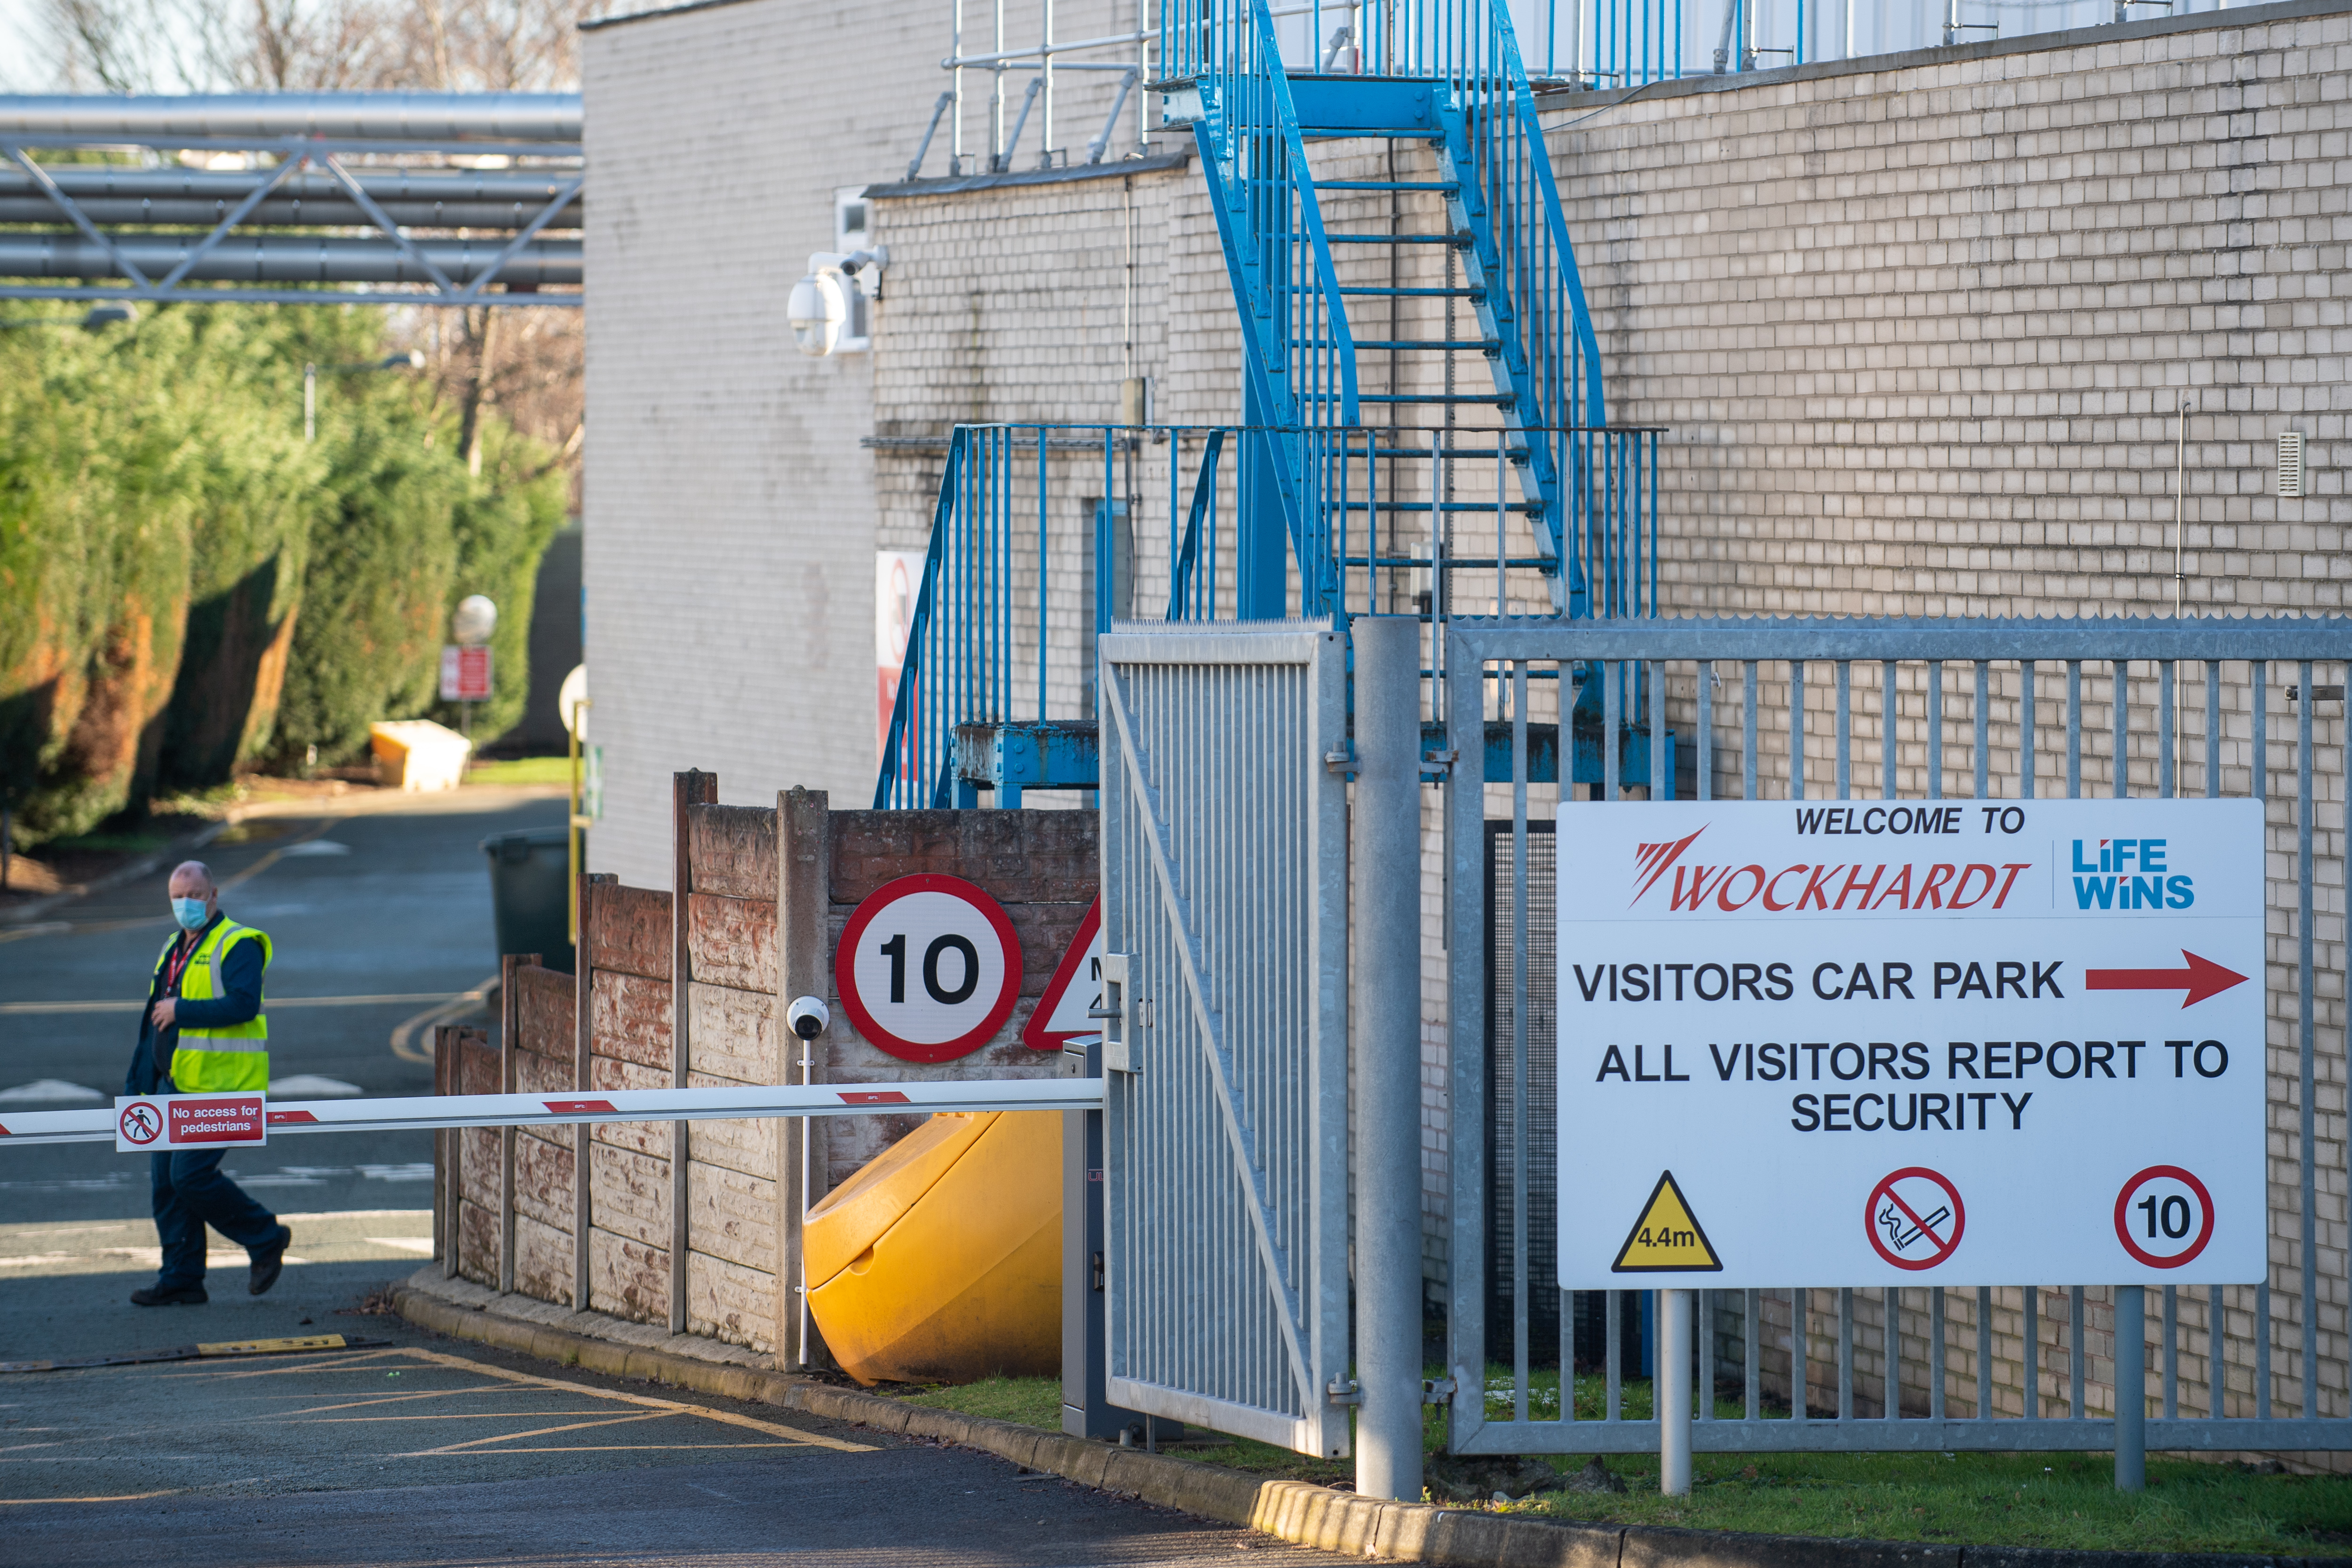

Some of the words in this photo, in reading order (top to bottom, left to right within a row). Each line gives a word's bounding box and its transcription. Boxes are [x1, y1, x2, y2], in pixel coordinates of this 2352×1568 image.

[1796, 806, 1963, 835] WELCOME
[1981, 806, 2026, 835] TO
[1669, 863, 2032, 912] WOCKHARDT
[880, 934, 979, 1005] 10
[1573, 963, 1794, 1002] VISITORS
[1812, 962, 1915, 1000] CAR
[1933, 961, 2066, 1000] PARK
[1596, 1044, 1690, 1082] ALL
[1708, 1042, 1931, 1081] VISITORS
[1948, 1041, 2146, 1079] REPORT
[2164, 1039, 2229, 1078] TO
[173, 1108, 190, 1118] No
[194, 1107, 237, 1117] access
[241, 1105, 258, 1115] for
[181, 1121, 251, 1136] pedestrians
[1791, 1091, 2034, 1132] SECURITY
[1637, 1227, 1694, 1247] 4.4m
[2137, 1195, 2191, 1239] 10
